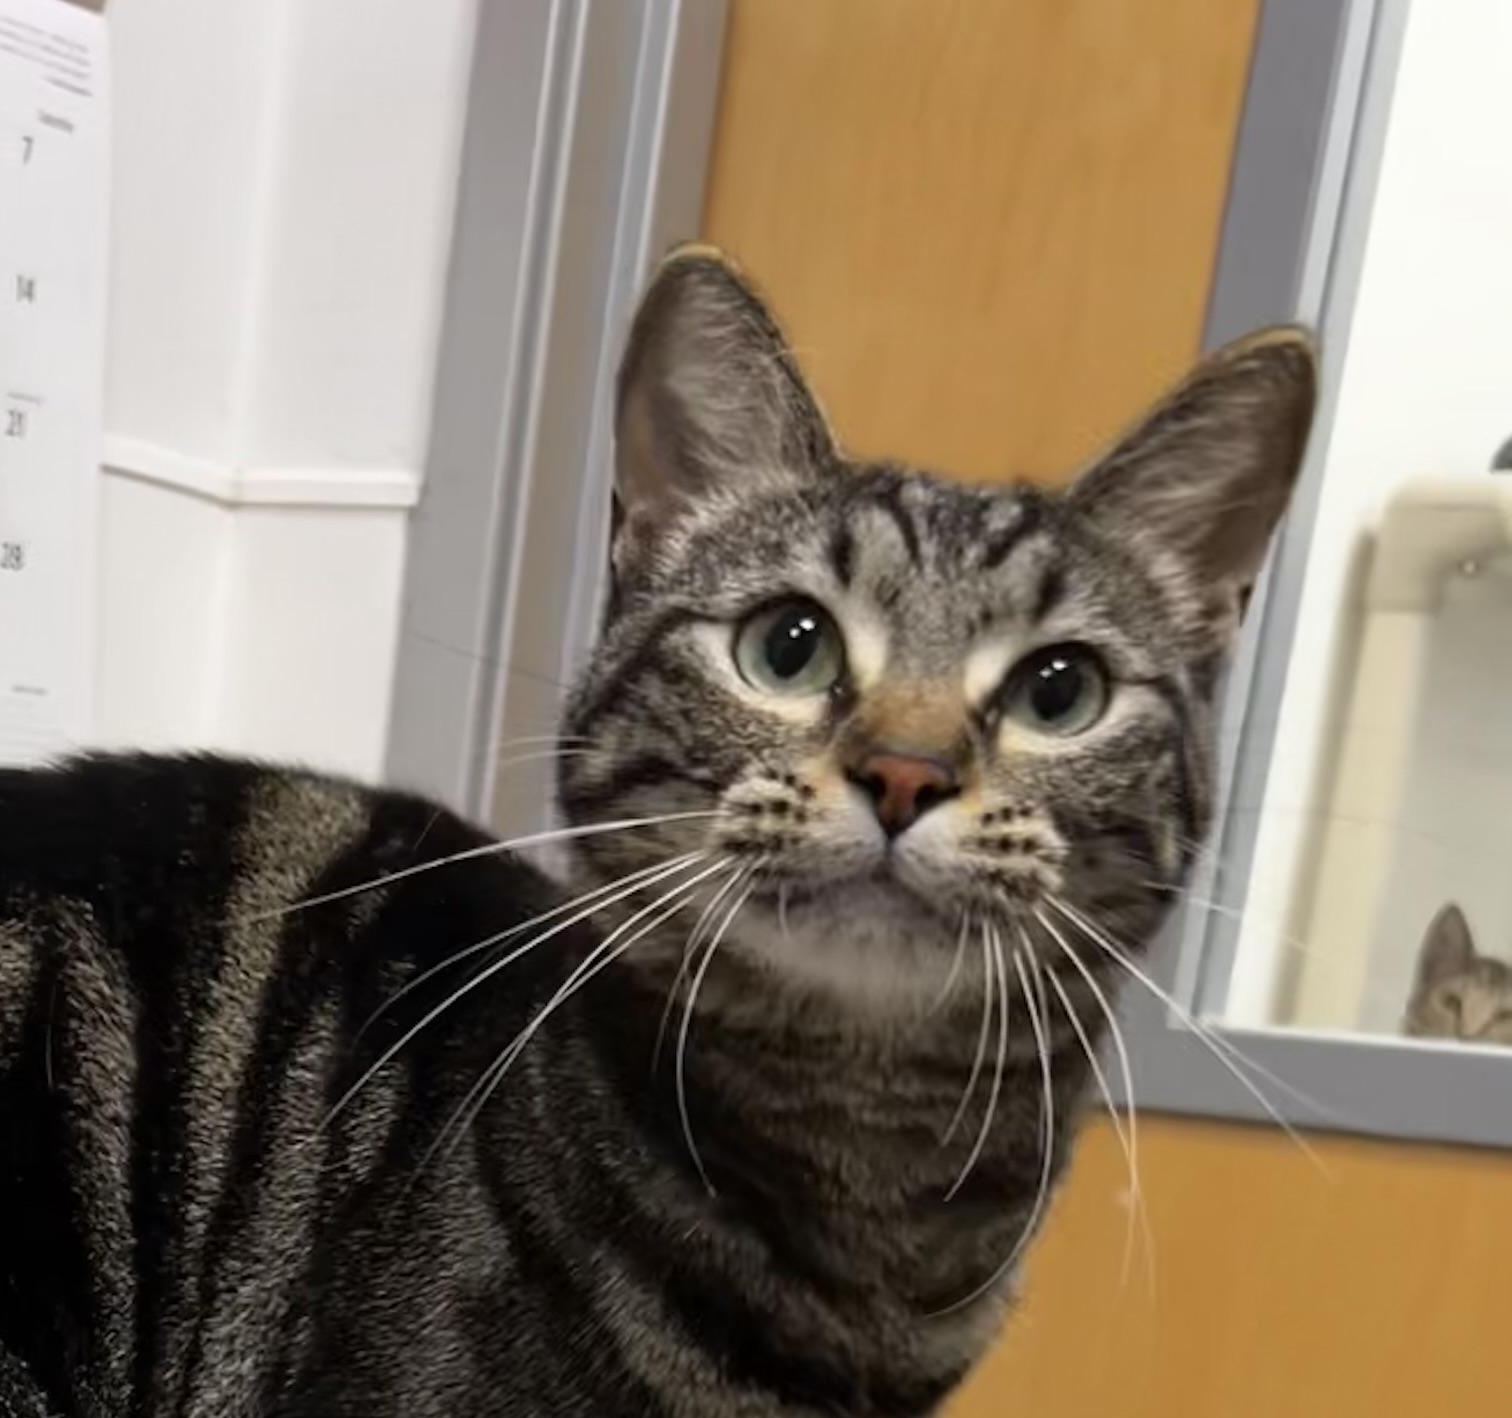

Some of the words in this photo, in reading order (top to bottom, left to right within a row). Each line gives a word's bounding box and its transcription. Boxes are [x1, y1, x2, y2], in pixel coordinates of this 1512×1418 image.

[21, 136, 35, 164] 7
[17, 275, 35, 302] 14
[5, 408, 25, 437] 21
[0, 542, 23, 570] 28
